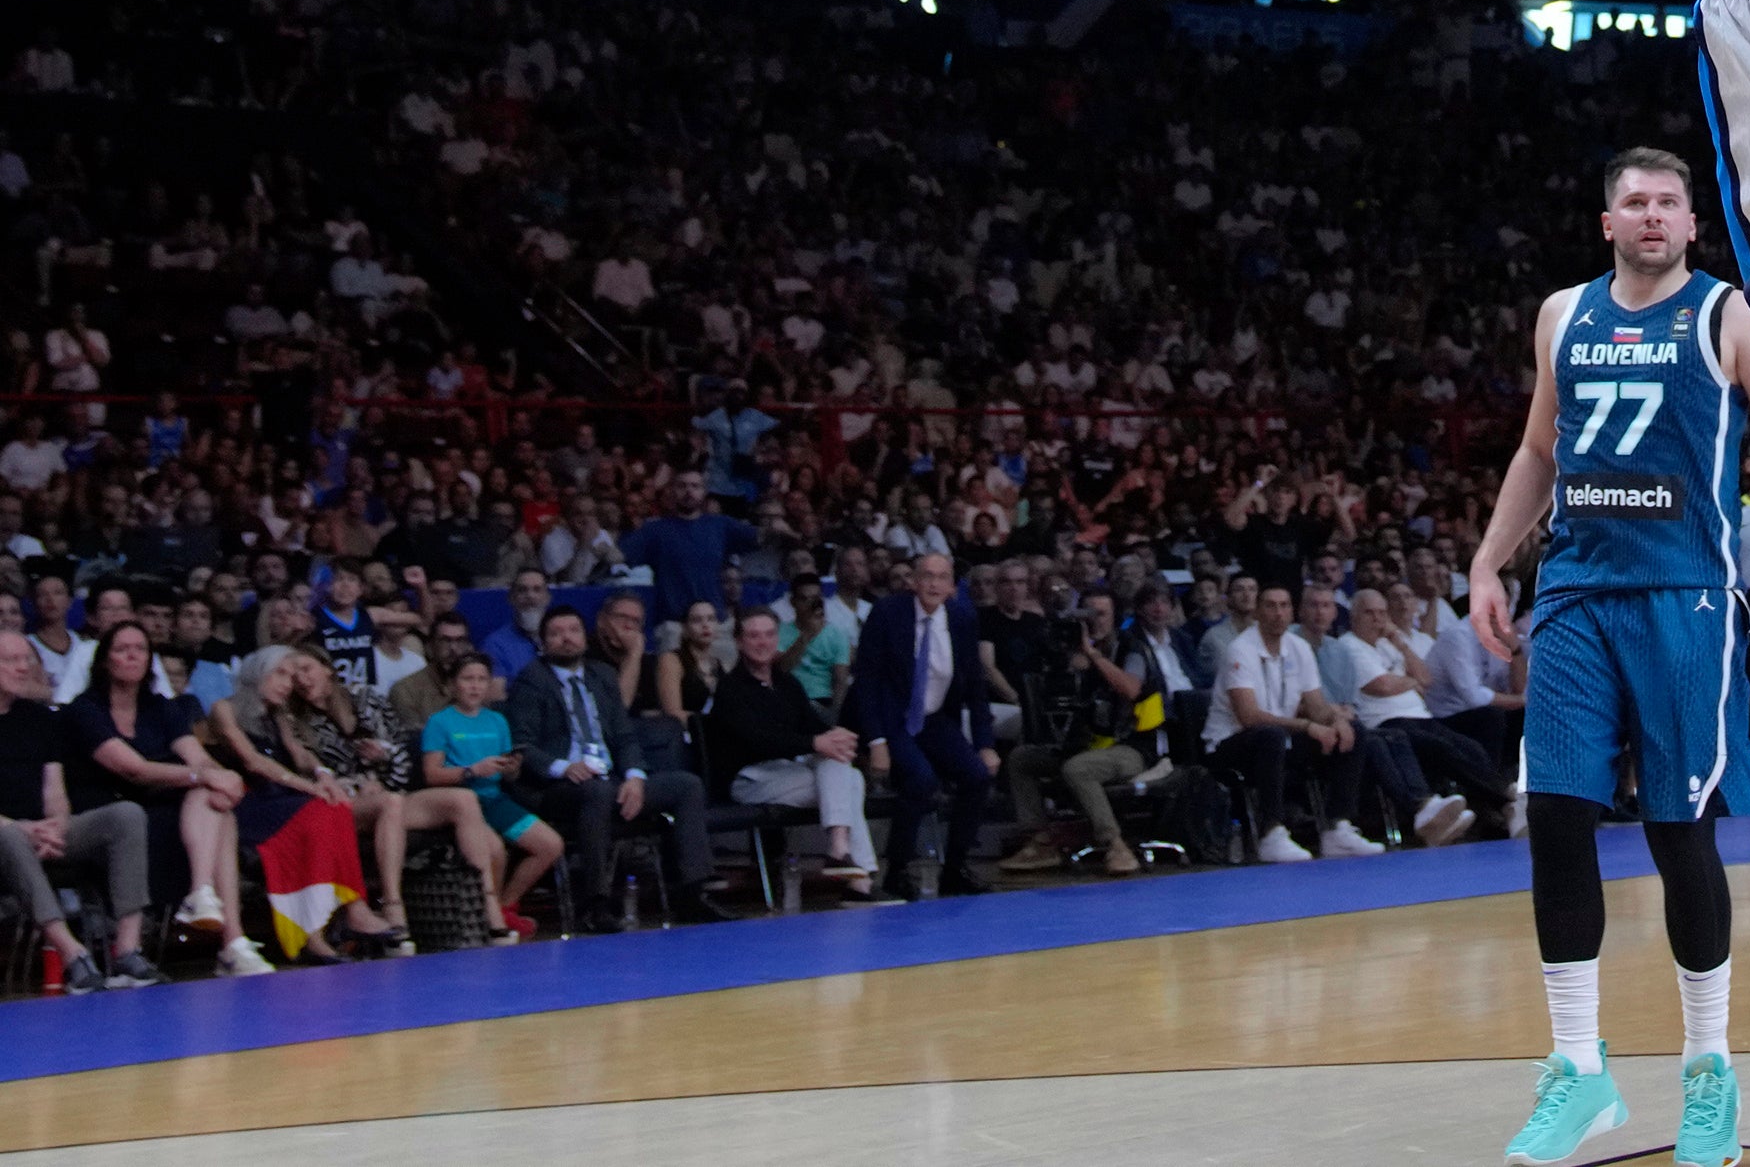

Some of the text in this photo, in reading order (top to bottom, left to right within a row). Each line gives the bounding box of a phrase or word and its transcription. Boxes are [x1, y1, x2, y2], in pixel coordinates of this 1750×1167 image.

[1569, 342, 1678, 366] SLOVENIJA
[1573, 381, 1664, 456] 77
[1565, 484, 1673, 508] telemach
